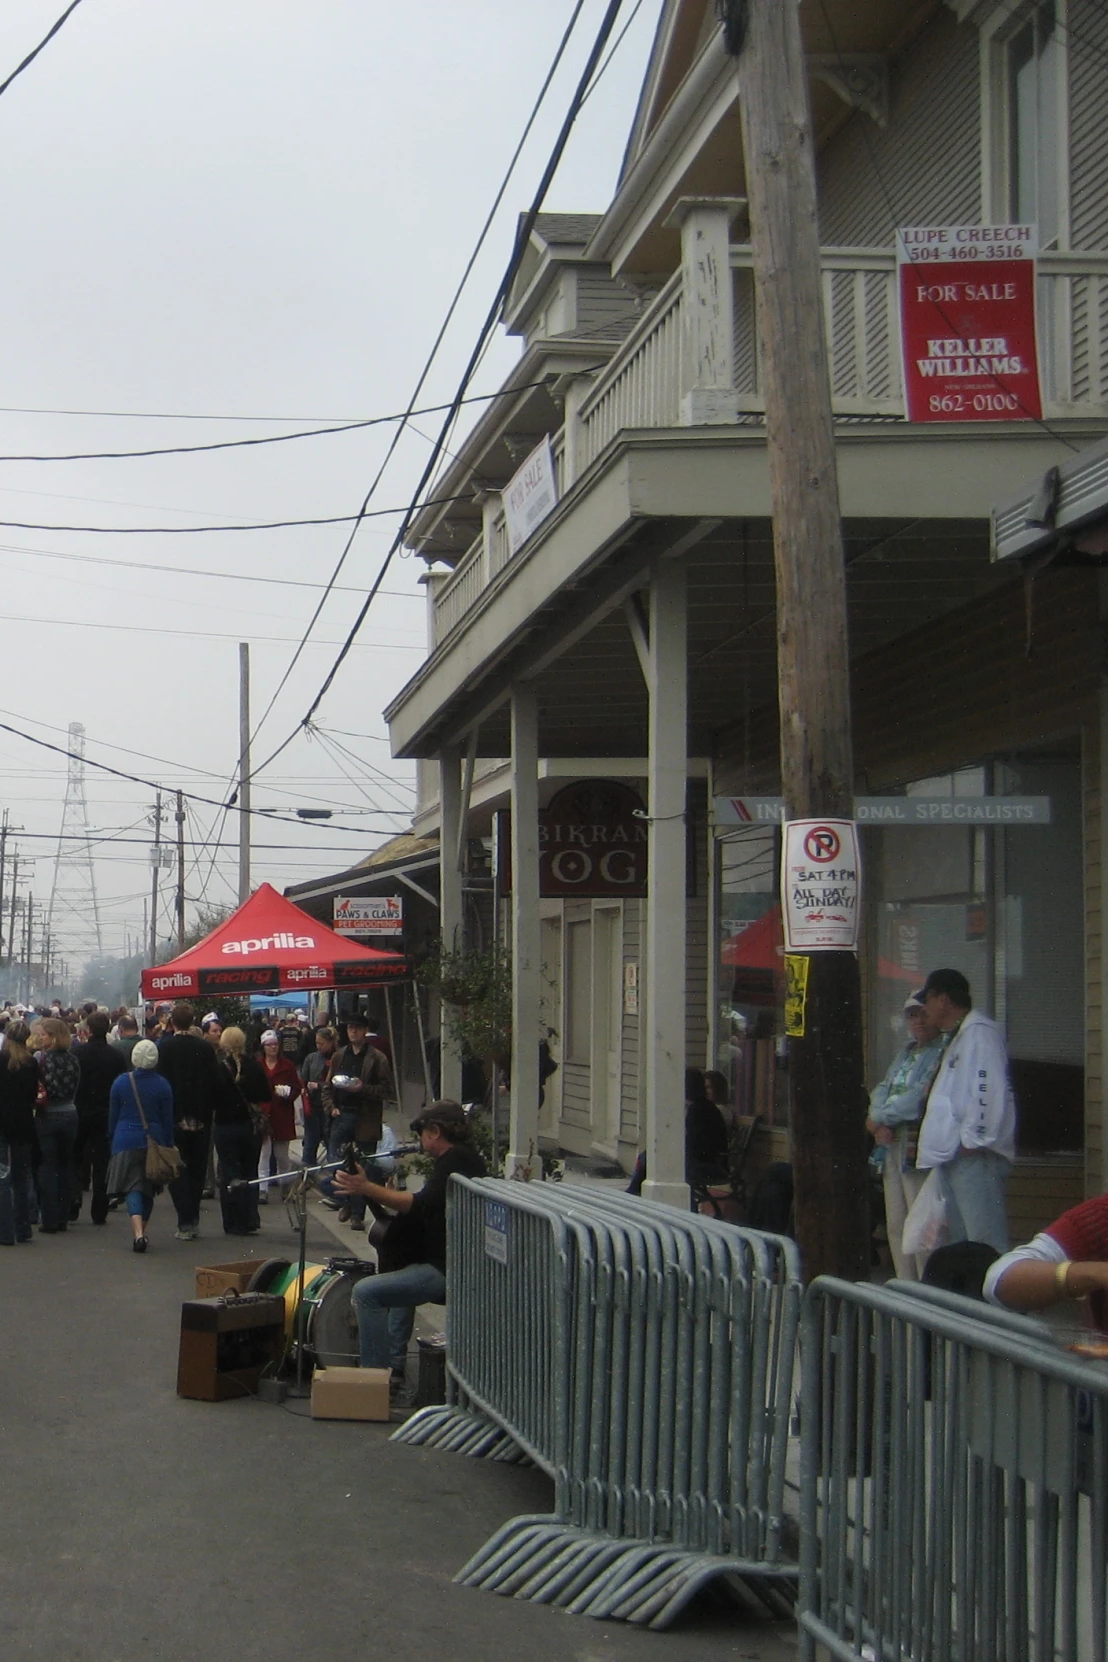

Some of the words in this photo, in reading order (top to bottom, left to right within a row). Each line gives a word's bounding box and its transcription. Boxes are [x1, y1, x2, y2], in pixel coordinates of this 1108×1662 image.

[904, 229, 948, 244] LUPE
[956, 227, 1031, 243] CREECH
[910, 244, 1023, 261] 504-460-3516
[916, 284, 957, 302] FOR
[965, 282, 1017, 301] SALE
[927, 337, 1008, 358] KELLER
[916, 356, 1022, 378] WILLIAMS
[915, 802, 1034, 820] SPECIALISTS
[539, 849, 649, 884] OG
[798, 870, 824, 882] SAT
[793, 888, 815, 900] ALL
[822, 886, 847, 899] DAY
[336, 909, 361, 919] PAWS
[363, 911, 370, 919] &
[372, 909, 400, 919] CLAWS
[338, 920, 352, 928] PET
[353, 920, 398, 928] GROOMING
[221, 933, 315, 955] aprilia
[151, 973, 192, 991] aprilia
[205, 968, 273, 985] racing
[286, 966, 327, 982] aprilia
[977, 1069, 987, 1135] BELIZ
